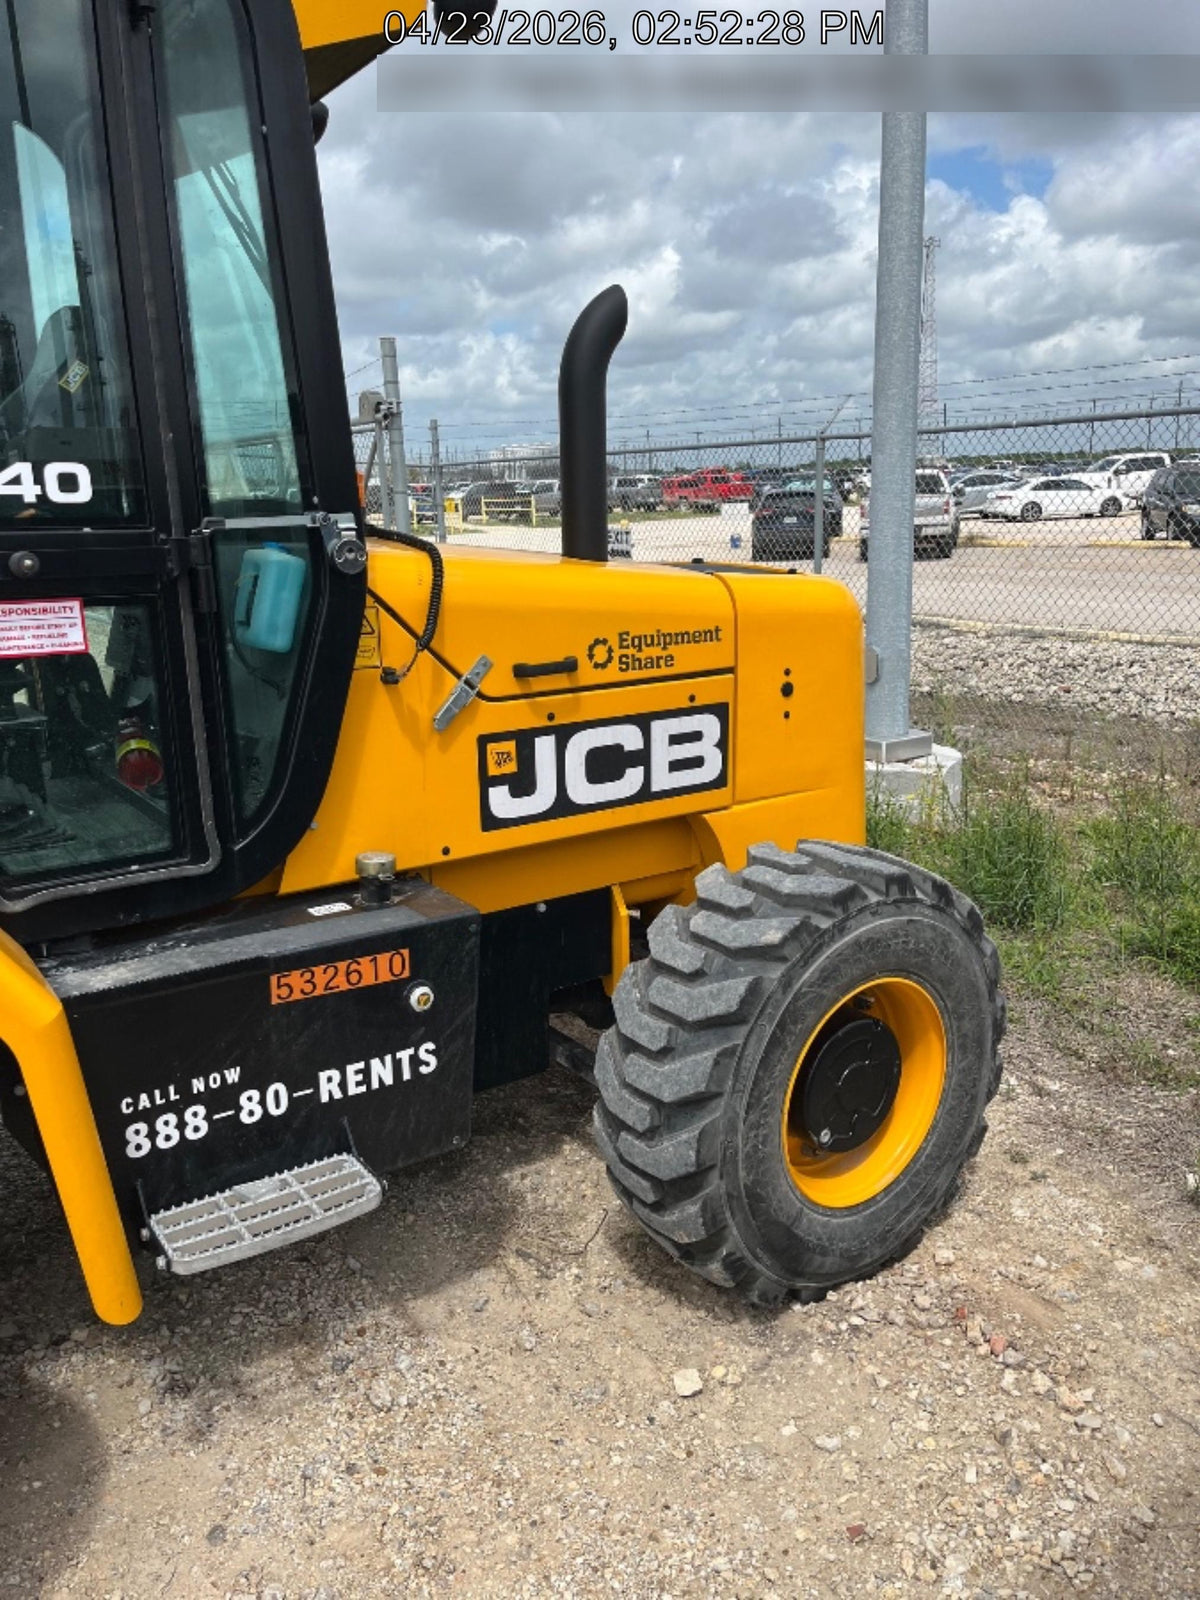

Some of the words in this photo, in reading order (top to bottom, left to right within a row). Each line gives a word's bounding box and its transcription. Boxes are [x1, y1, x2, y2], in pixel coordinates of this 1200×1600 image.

[0, 605, 74, 617] SPONSIBILITY
[618, 625, 723, 653] Equipment
[618, 653, 675, 673] Share
[488, 713, 723, 819] JCB
[276, 951, 406, 1000] 532610
[120, 1084, 180, 1114] CALL
[191, 1066, 241, 1094] NOW
